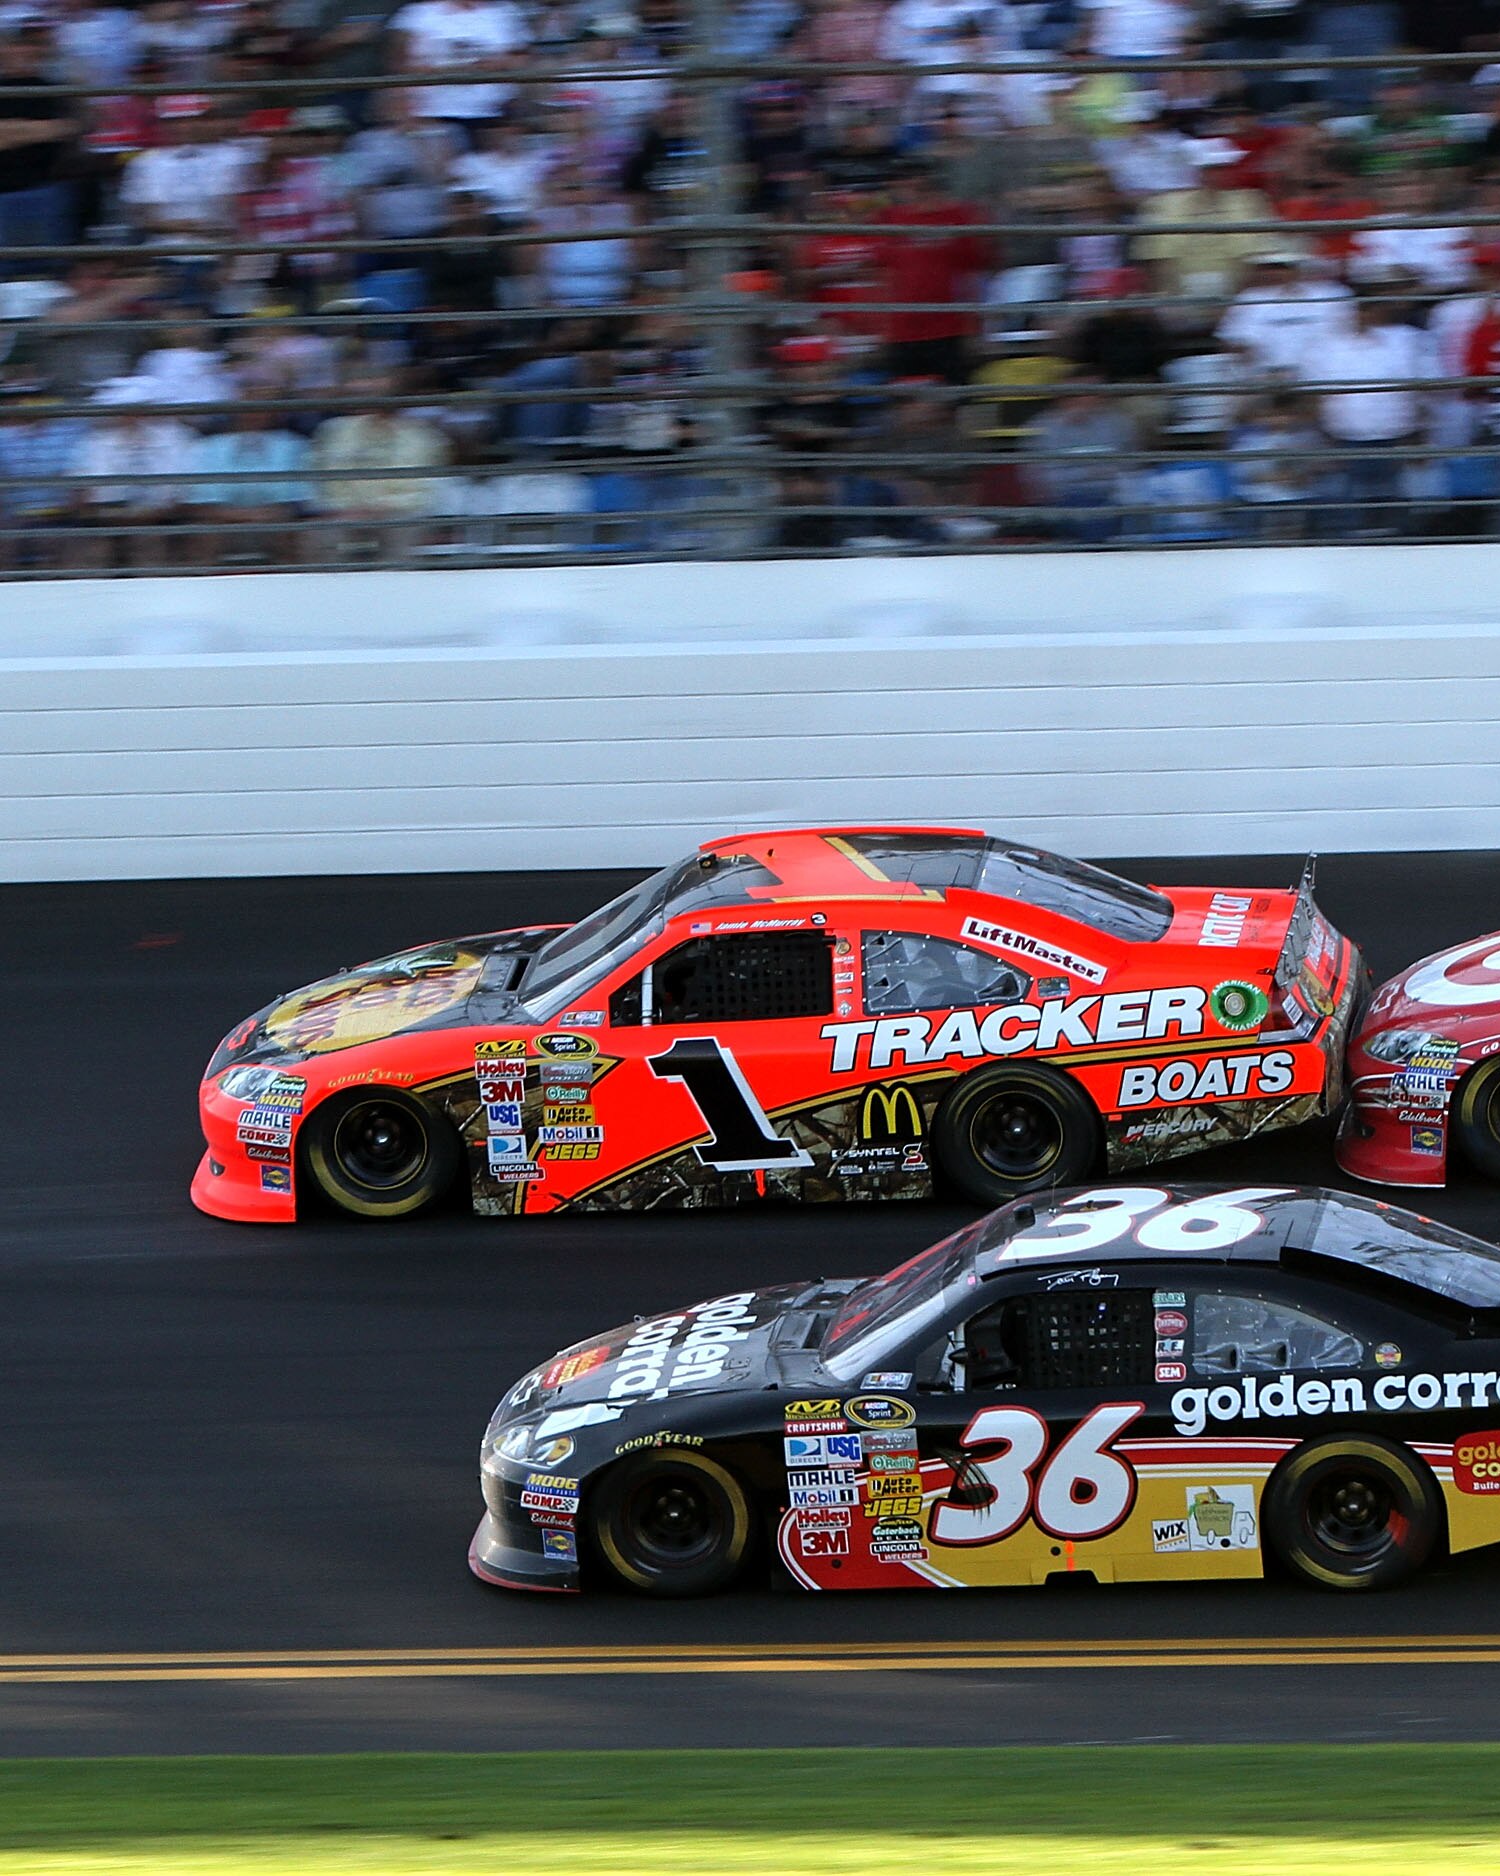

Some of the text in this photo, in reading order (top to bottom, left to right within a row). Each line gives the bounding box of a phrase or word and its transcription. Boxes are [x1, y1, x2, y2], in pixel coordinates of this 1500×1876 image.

[715, 919, 806, 930] Jamie McMurray
[813, 913, 826, 923] 3
[967, 920, 1099, 978] LiftMaster
[1212, 979, 1262, 996] AMERICAN
[820, 986, 1205, 1072] TRACKER
[1218, 1013, 1266, 1031] ETHANOL
[554, 1041, 576, 1052] Sprint
[476, 1060, 525, 1077] Holley
[1408, 1057, 1455, 1071] MOOG
[1118, 1051, 1294, 1107] BOATS
[1393, 1073, 1445, 1091] MAHLE
[482, 1081, 523, 1102] 3M
[547, 1085, 588, 1100] O'Reilly
[1390, 1091, 1430, 1104] COMP
[257, 1095, 303, 1108] MOOG
[645, 1036, 815, 1172] 1
[489, 1104, 519, 1127] USG
[560, 1107, 585, 1115] Auto
[1399, 1110, 1442, 1124] Edelbrock
[239, 1110, 291, 1129] MAHLE
[557, 1115, 592, 1123] Meter
[1126, 1116, 1219, 1137] MERCURY
[238, 1129, 276, 1142] COMP
[543, 1127, 582, 1139] Mobil
[247, 1148, 290, 1162] Edelbrock
[545, 1143, 600, 1160] JEGS
[493, 1164, 534, 1172] LINCOLN
[503, 1172, 540, 1180] WELDERS
[998, 1187, 1299, 1261] 36
[669, 1292, 757, 1388] golden
[608, 1315, 687, 1401] corral
[1158, 1366, 1181, 1378] SEM
[1171, 1374, 1368, 1436] golden
[868, 1409, 891, 1419] Sprint
[787, 1421, 844, 1433] CRAFTSMAN
[615, 1431, 704, 1455] GOODYEAR
[827, 1435, 860, 1460] USG
[872, 1455, 916, 1471] O'Reilly
[527, 1473, 579, 1490] MOOG
[789, 1471, 854, 1486] MAHLE
[884, 1477, 912, 1485] Auto
[927, 1400, 1146, 1548] 36
[794, 1489, 836, 1504] Mobil
[882, 1485, 919, 1495] Meter
[523, 1493, 562, 1507] COMP
[864, 1498, 922, 1517] JEGS
[531, 1512, 575, 1528] Edelbrock
[797, 1508, 849, 1523] Holley
[872, 1526, 920, 1536] Gatorback
[1154, 1521, 1186, 1541] WIX
[802, 1531, 847, 1554] 3M
[873, 1543, 918, 1553] LINCOLN
